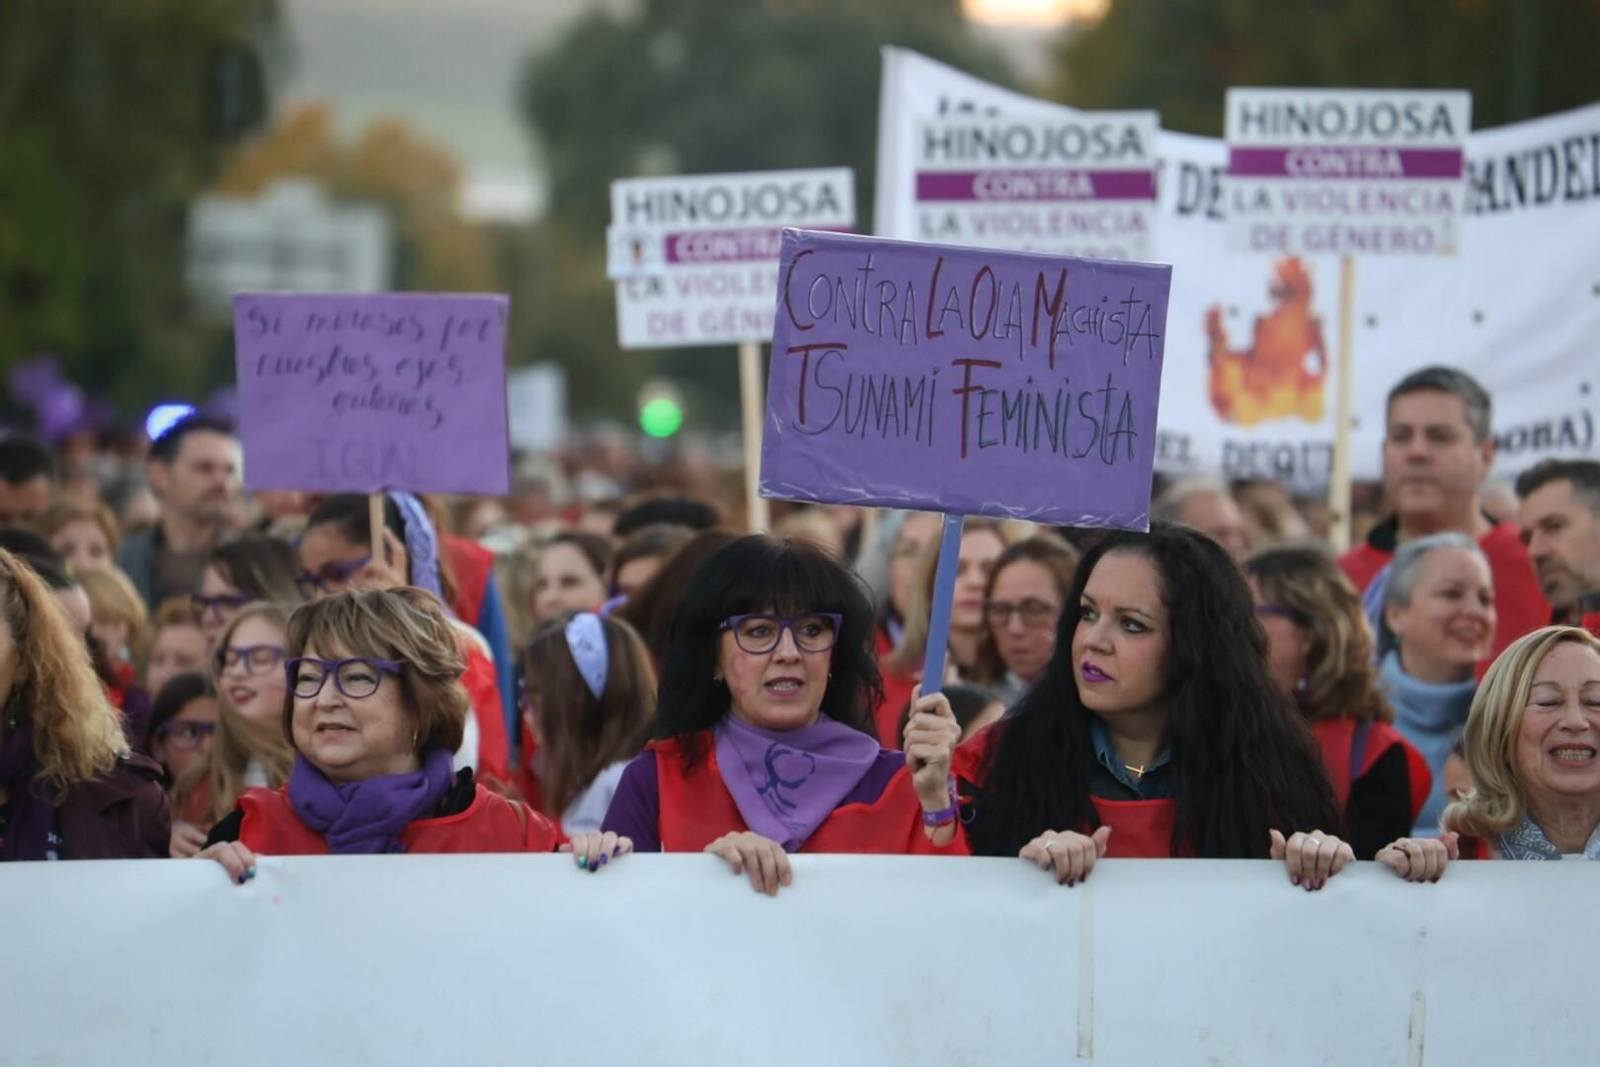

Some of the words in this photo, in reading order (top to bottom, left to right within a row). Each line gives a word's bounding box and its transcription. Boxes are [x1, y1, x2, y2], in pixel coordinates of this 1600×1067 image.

[1238, 100, 1457, 137] HINOJOSA
[922, 122, 1144, 160] HINOJOSA
[1284, 149, 1404, 176] CONTRA
[972, 171, 1096, 199] CONTRA
[625, 182, 841, 223] HINOJOSA
[1233, 188, 1272, 214] LA
[1283, 187, 1456, 215] VIOLENCIA
[919, 211, 961, 237] LA
[970, 209, 1148, 238] VIOLENCIA
[1251, 224, 1288, 252] DE
[1302, 220, 1436, 253] GÉNERO
[646, 309, 685, 340] DE
